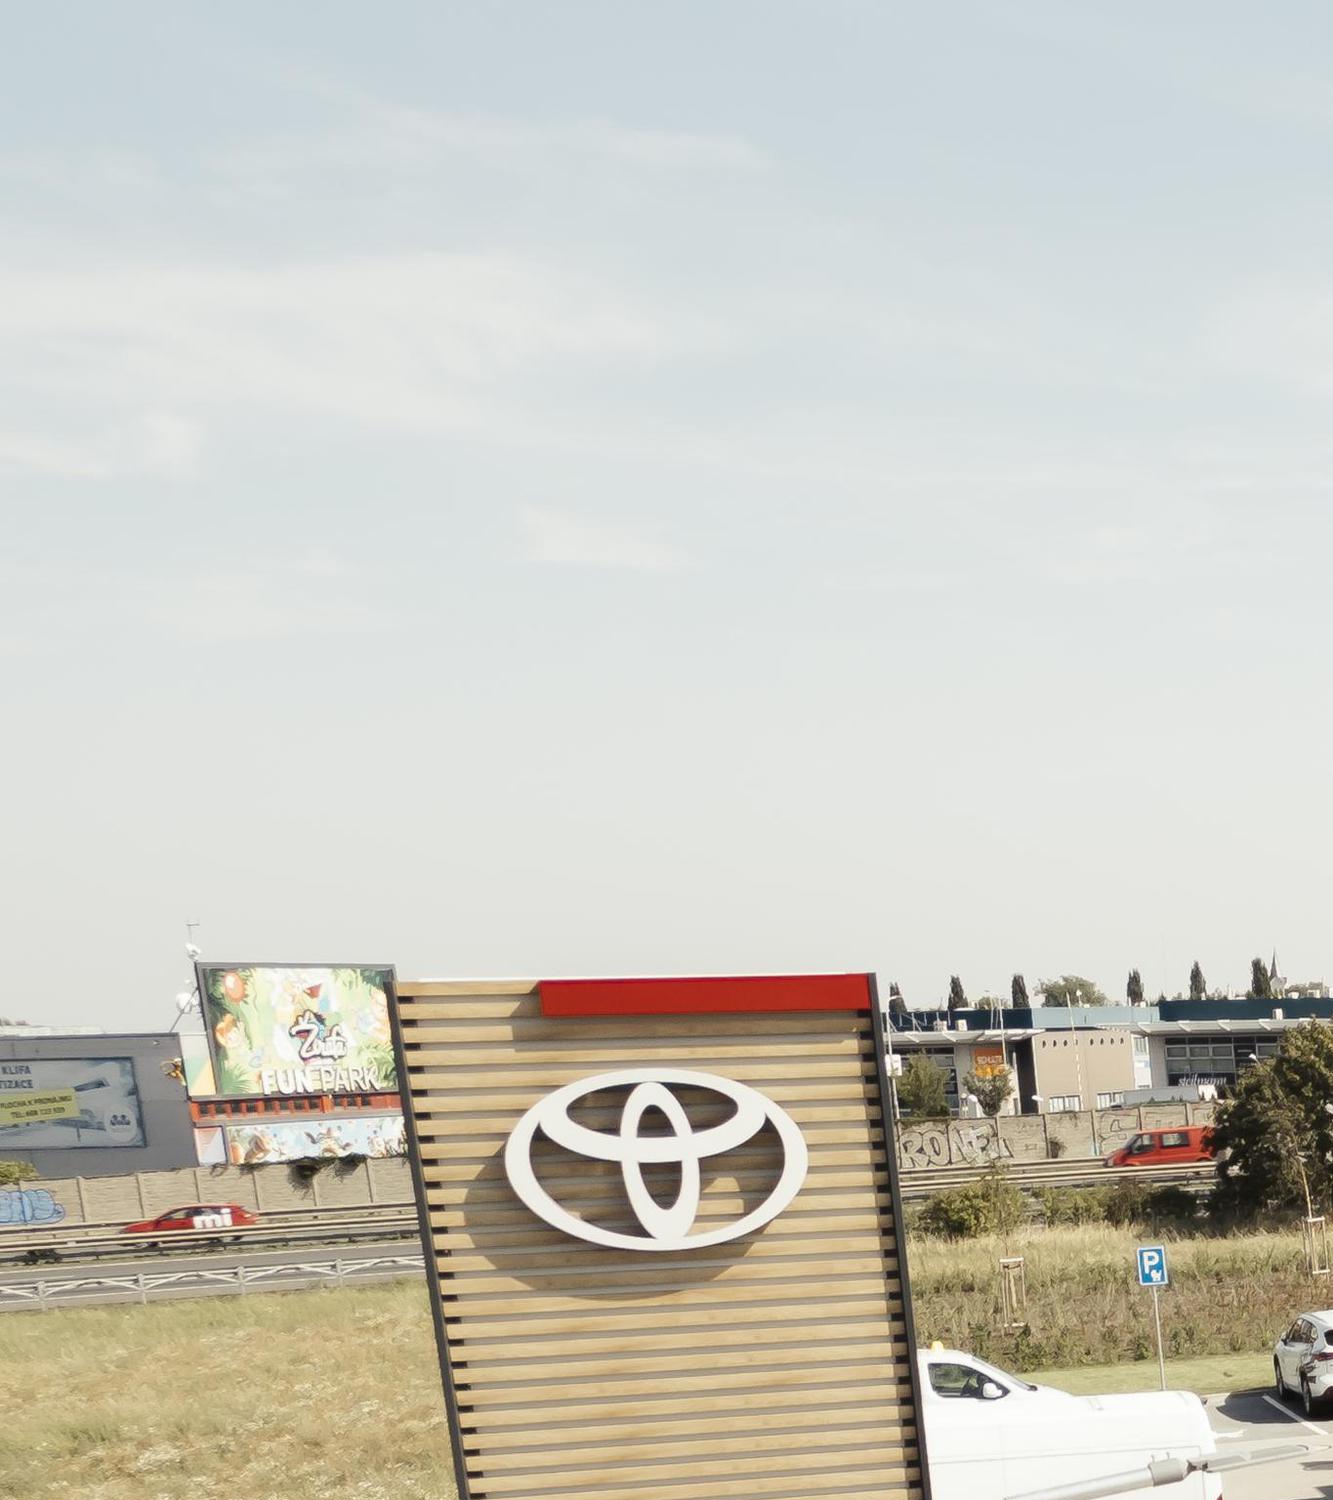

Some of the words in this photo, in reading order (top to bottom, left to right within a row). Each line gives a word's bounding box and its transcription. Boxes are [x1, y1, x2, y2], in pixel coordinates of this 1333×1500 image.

[261, 1068, 314, 1095] FUN
[320, 1066, 380, 1093] PARK
[1143, 1251, 1160, 1274] P
